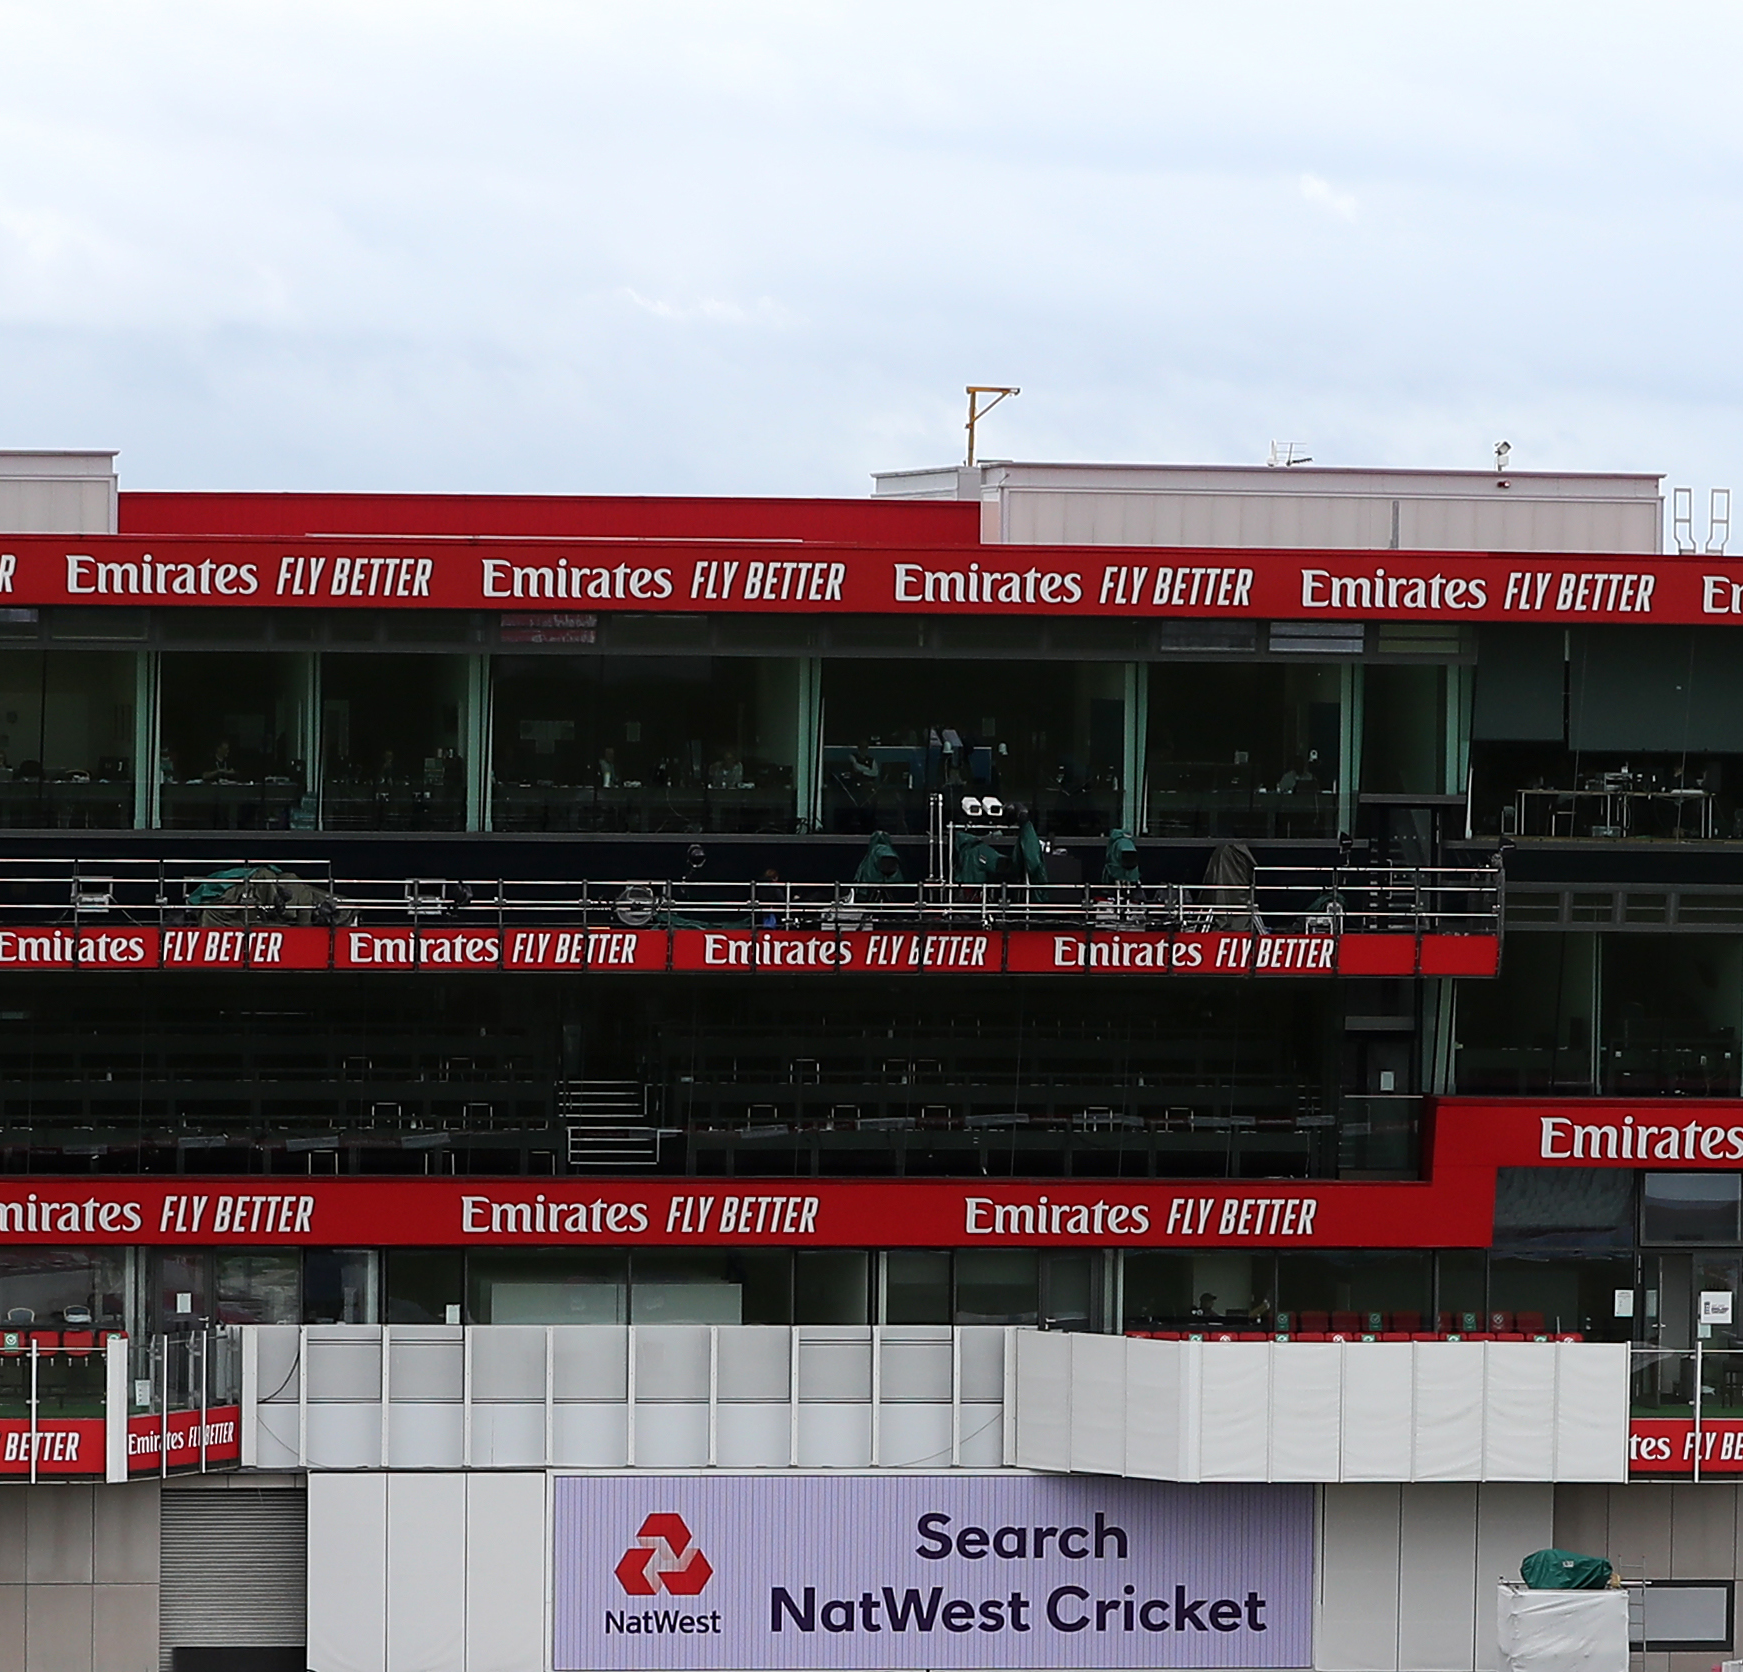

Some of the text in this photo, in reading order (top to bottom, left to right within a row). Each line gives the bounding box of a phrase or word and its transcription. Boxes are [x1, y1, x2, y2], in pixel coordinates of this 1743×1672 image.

[66, 554, 432, 596] Emirates FLY BETTER
[482, 559, 845, 600] Emirates FLY BETTER
[895, 563, 1253, 605] Emirates FLY BETTER
[1302, 569, 1654, 611] Emirates FLY BETTER
[164, 932, 199, 961] FLY
[204, 932, 282, 962] BETTER
[350, 933, 636, 963] Emirates FLY BETTER
[705, 934, 851, 964] Emirates
[866, 936, 904, 964] FLY
[1055, 936, 1334, 967] Emirates FLY BETTER
[160, 1196, 208, 1231] FLY
[214, 1196, 313, 1232] BETTER
[462, 1195, 818, 1232] Emirates FLY BETTER
[965, 1197, 1316, 1234] Emirates FLY BETTER
[4, 1432, 80, 1462] BETTER
[916, 1512, 1127, 1559] Search
[606, 1610, 721, 1634] NatWest
[772, 1585, 1267, 1632] NatWest Cricket
